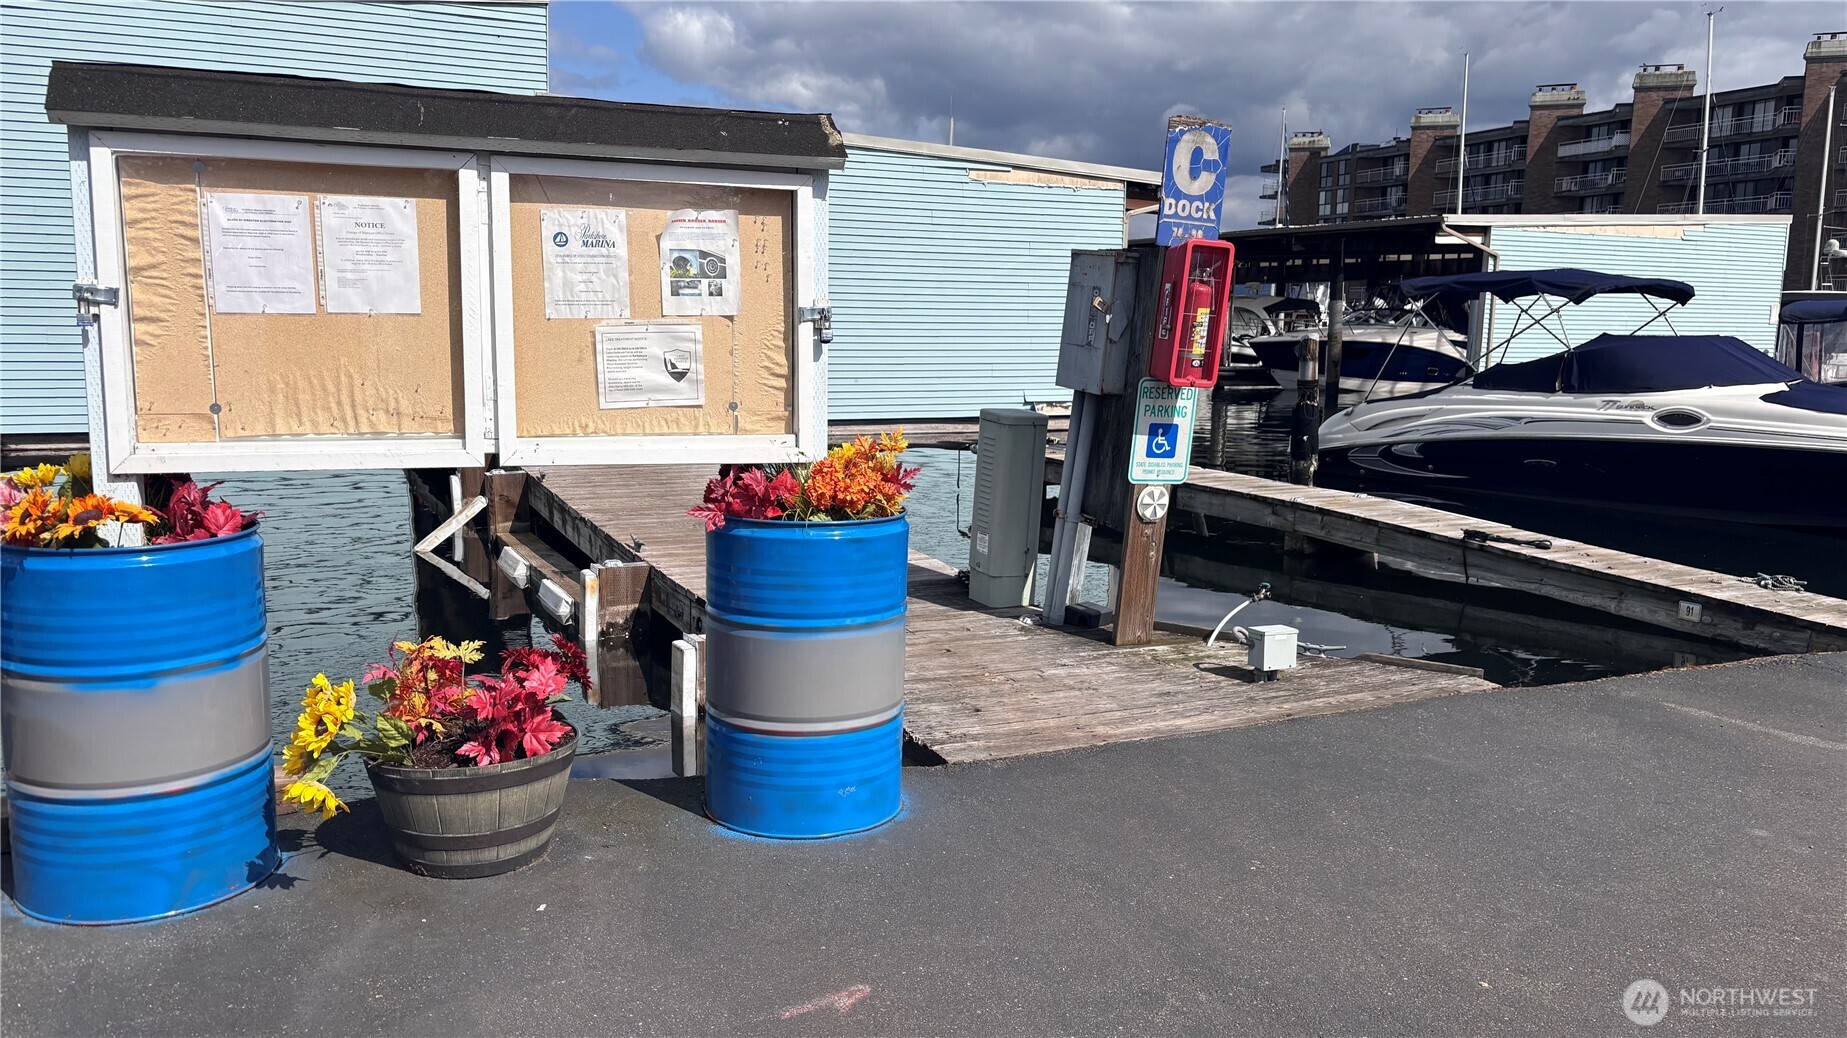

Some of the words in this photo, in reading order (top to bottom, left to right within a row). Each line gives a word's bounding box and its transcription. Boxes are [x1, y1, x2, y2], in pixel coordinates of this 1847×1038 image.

[1173, 130, 1219, 195] C
[1164, 198, 1216, 219] DOCK
[354, 221, 386, 229] NOTICE
[581, 240, 615, 248] MARINA
[1142, 387, 1193, 401] RESERVED
[1144, 405, 1188, 418] PARKING
[1686, 606, 1694, 617] 91
